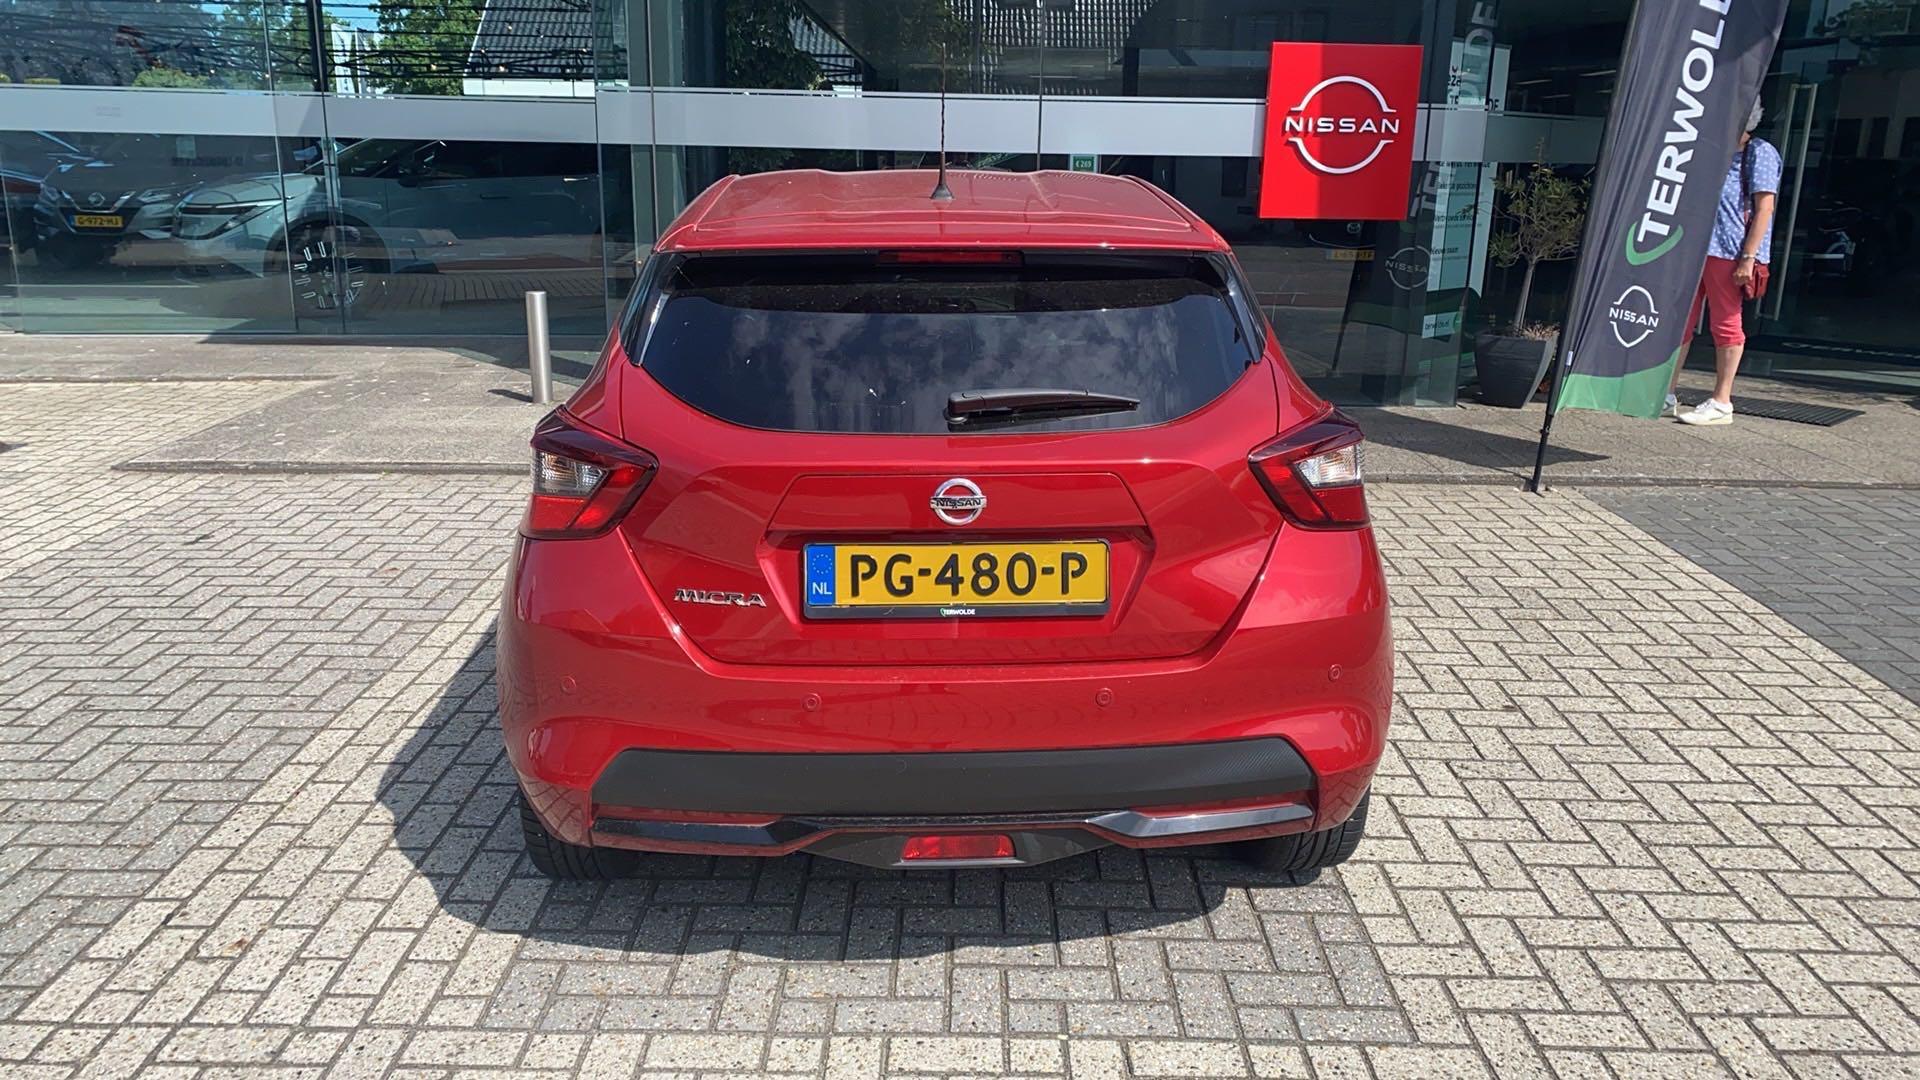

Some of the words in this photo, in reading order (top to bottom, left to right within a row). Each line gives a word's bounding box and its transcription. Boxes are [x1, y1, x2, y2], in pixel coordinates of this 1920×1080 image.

[1285, 116, 1400, 134] NISSAN
[1609, 307, 1660, 328] NISSAN
[936, 497, 982, 507] NISSAN
[850, 551, 1088, 598] PG-480-P
[674, 588, 767, 607] MICRA
[811, 582, 832, 596] NL
[941, 608, 976, 616] TERWOLDE
